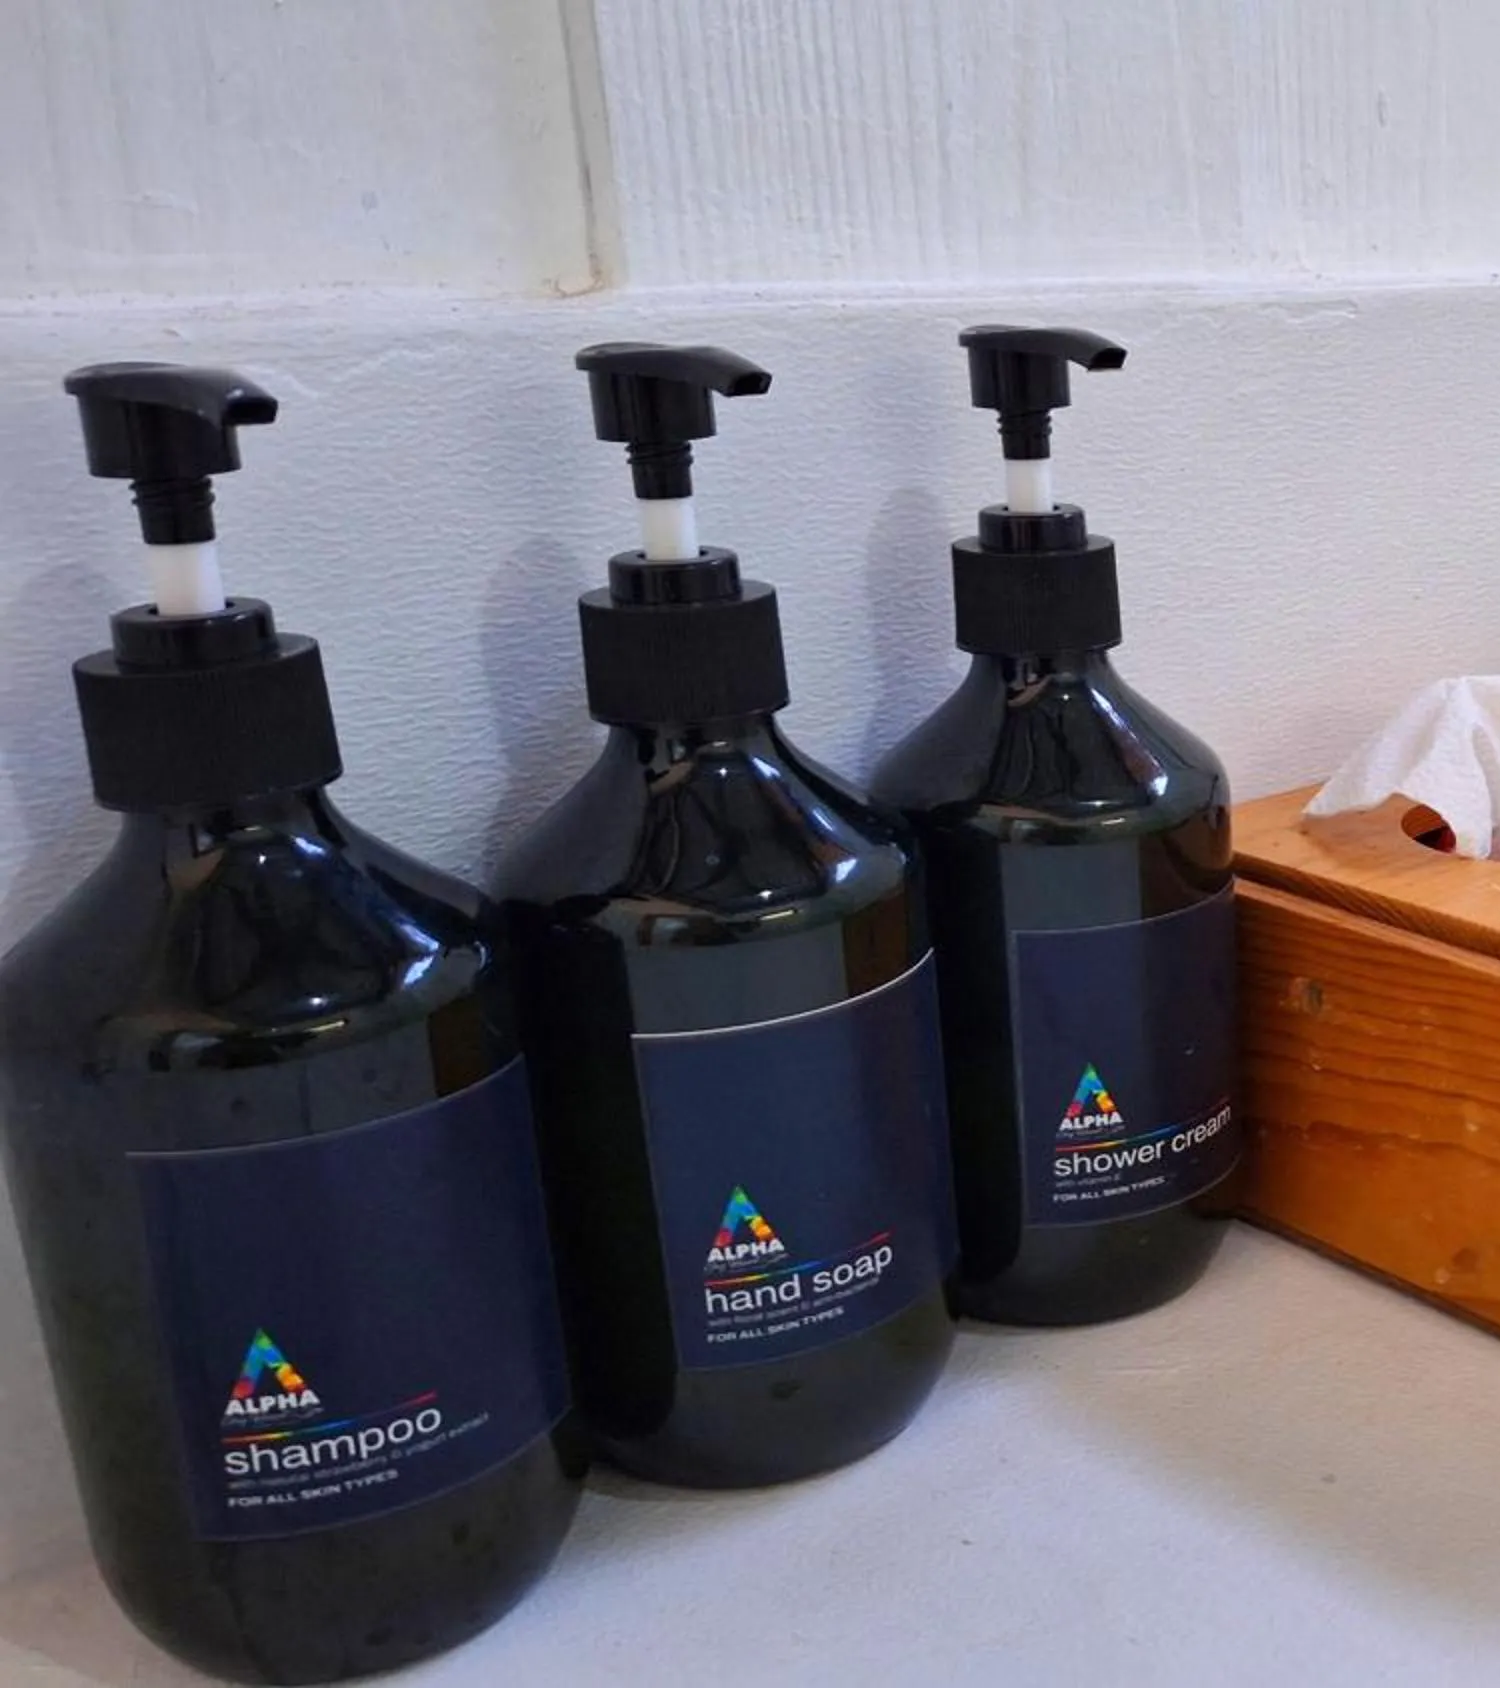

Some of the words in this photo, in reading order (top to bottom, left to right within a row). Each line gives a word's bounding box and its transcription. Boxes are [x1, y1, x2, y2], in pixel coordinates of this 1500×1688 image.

[1059, 1111, 1124, 1132] ALPHA
[1054, 1141, 1165, 1177] shower
[1171, 1105, 1231, 1153] cream
[1053, 1193, 1078, 1202] FOR
[1081, 1191, 1101, 1200] ALL
[1131, 1175, 1165, 1190] TYPES
[707, 1237, 785, 1263] ALPHA
[705, 1273, 801, 1313] hand
[812, 1246, 893, 1294] soap
[707, 1332, 737, 1343] FOR
[739, 1327, 764, 1339] ALL
[768, 1320, 801, 1335] SKIN
[802, 1306, 845, 1325] TYPES
[224, 1388, 321, 1416] ALPHA
[224, 1408, 442, 1475] shampoo
[227, 1496, 263, 1507] FOR
[266, 1492, 297, 1504] ALL
[300, 1483, 341, 1500] SKIN
[343, 1469, 399, 1491] TYPES
